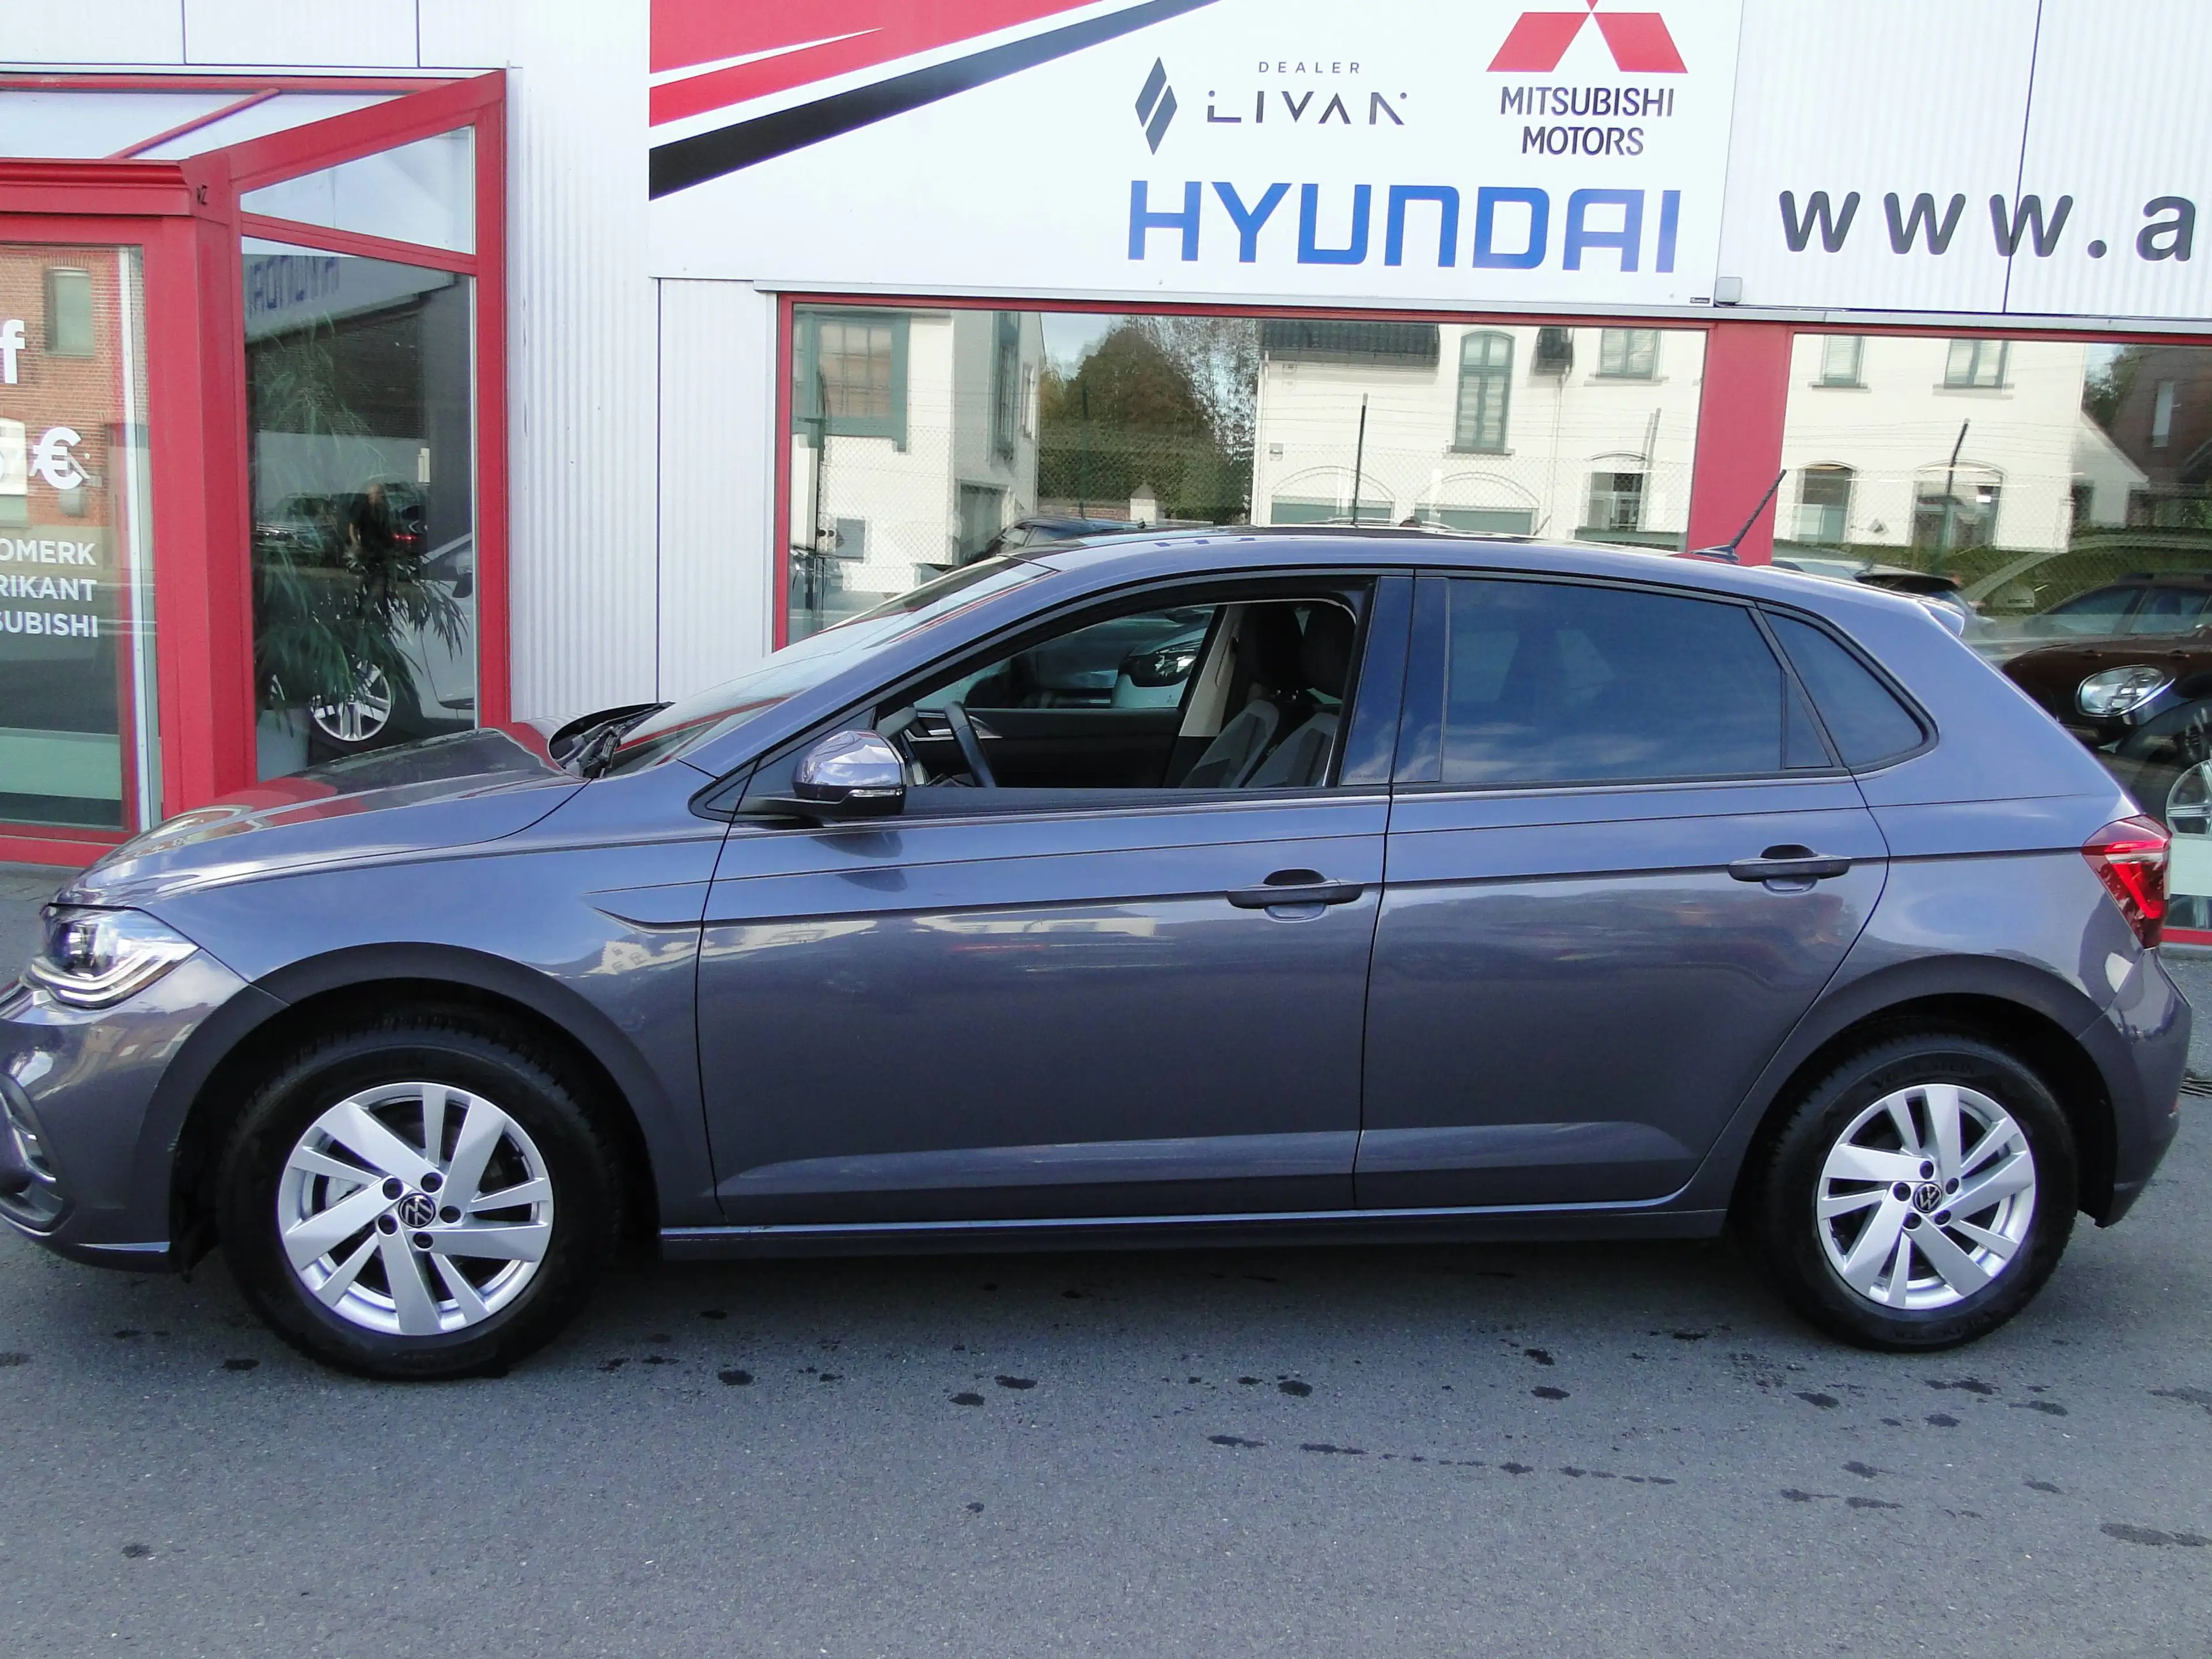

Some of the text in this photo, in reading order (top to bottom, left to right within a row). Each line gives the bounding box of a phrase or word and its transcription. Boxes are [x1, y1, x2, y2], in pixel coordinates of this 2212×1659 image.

[1259, 61, 1359, 74] DEALER
[1207, 90, 1407, 126] LIVAN
[1500, 86, 1675, 117] MITSUBISHI
[1521, 126, 1645, 156] MOTORS
[1127, 180, 1681, 273] HYUNDAI
[33, 427, 83, 490] €
[0, 610, 98, 638] UBISHI
